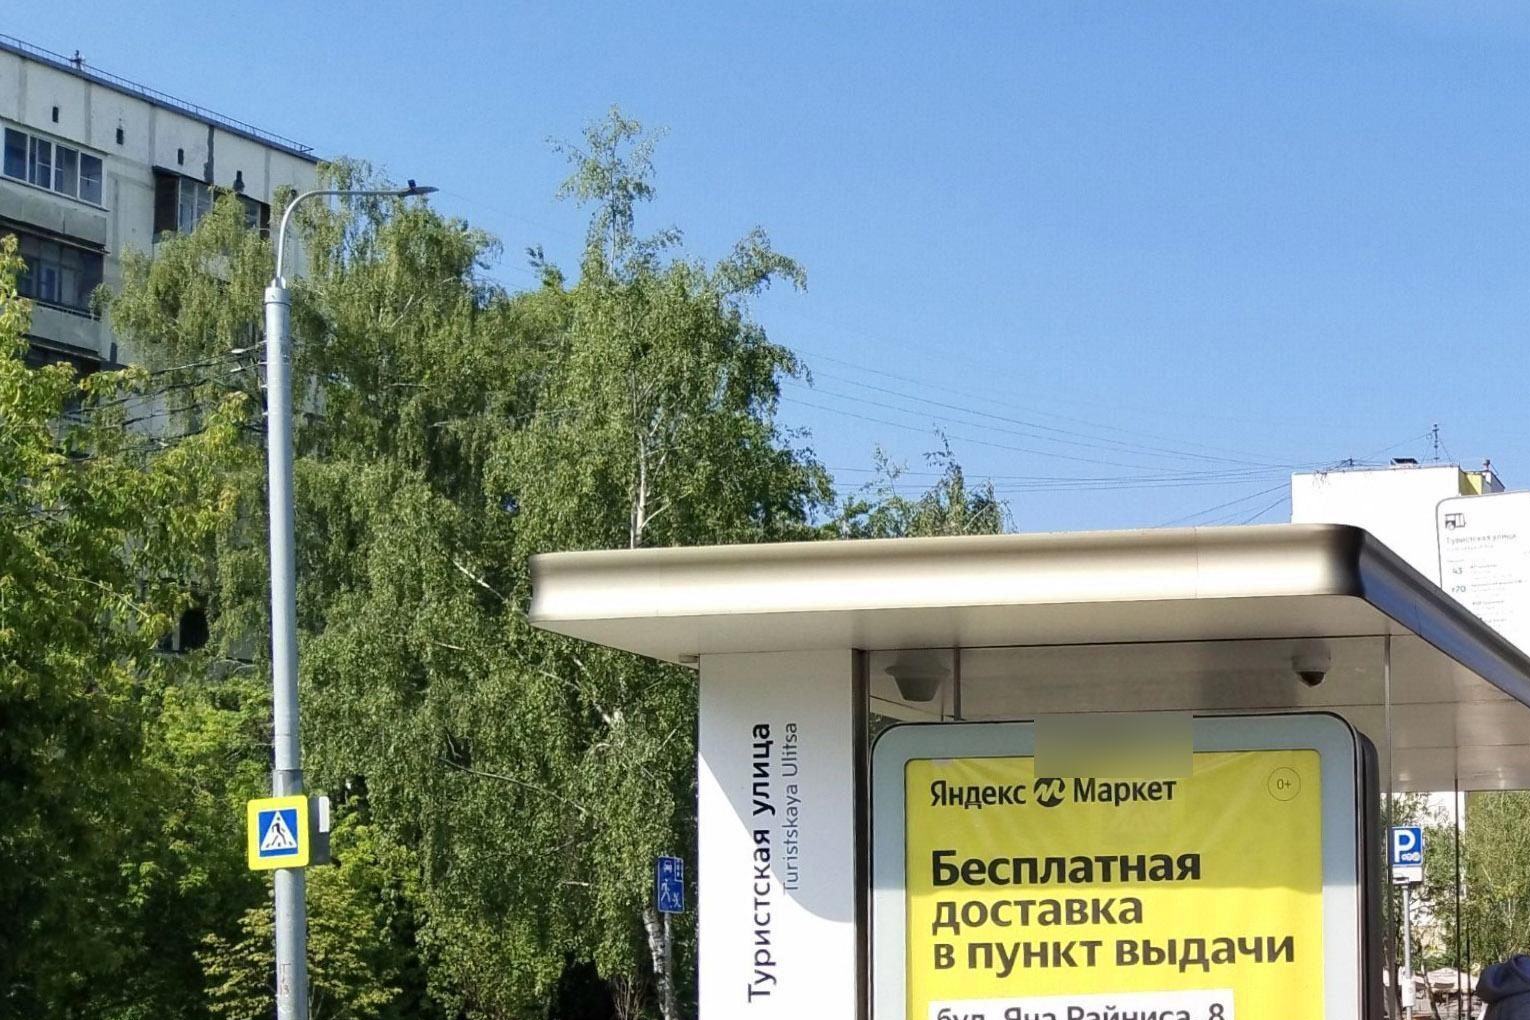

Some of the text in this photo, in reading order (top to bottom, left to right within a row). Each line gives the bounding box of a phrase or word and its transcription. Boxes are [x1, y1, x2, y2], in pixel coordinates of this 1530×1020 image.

[930, 777, 1177, 810] Яндекс Маркет
[1276, 778, 1293, 792] 0+
[781, 722, 801, 896] Turistskaya Ulitsa
[748, 723, 777, 1003] Туристская улица
[1394, 829, 1416, 863] P
[932, 850, 1201, 886] Бесплатная
[932, 897, 1143, 935] доставка
[934, 936, 1295, 978] в пункт выдачи
